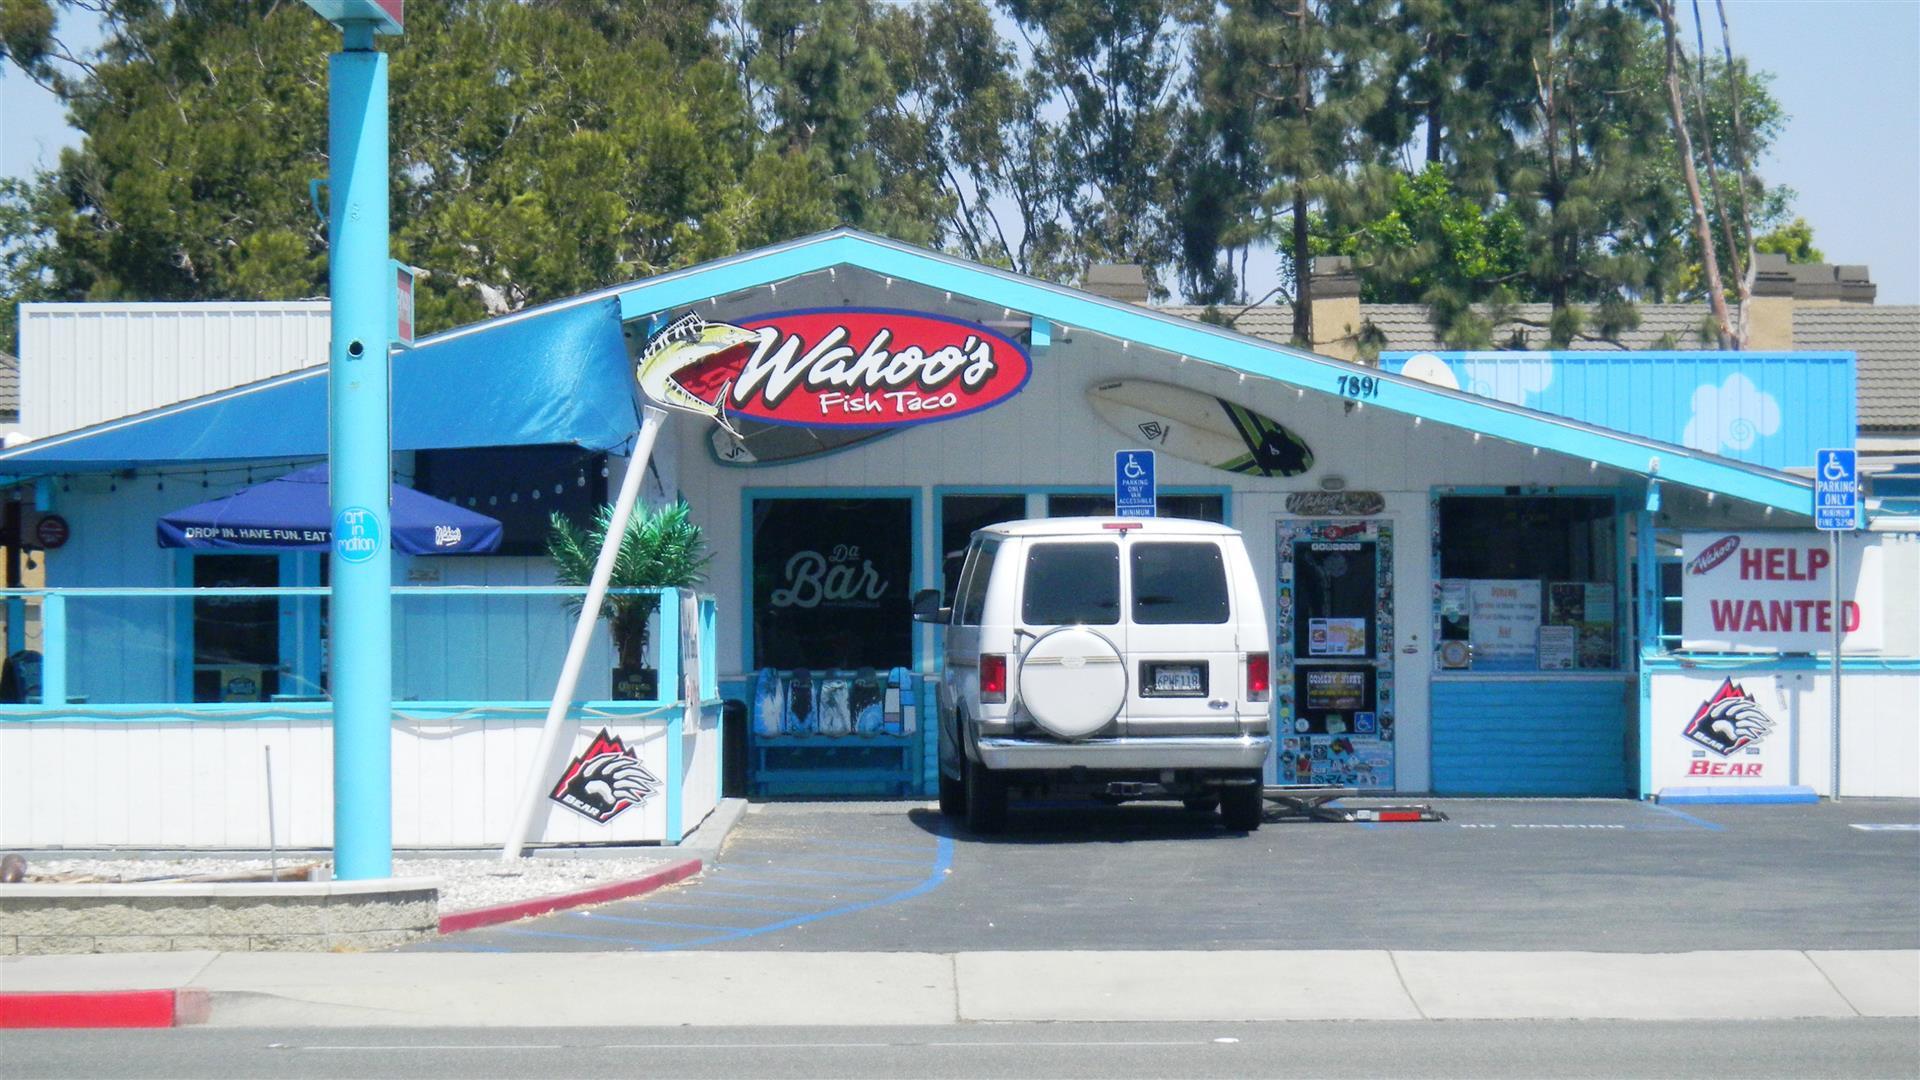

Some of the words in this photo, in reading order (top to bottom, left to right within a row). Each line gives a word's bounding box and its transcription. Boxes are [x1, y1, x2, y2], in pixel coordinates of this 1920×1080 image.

[732, 326, 994, 403] Wahoo's
[1336, 375, 1380, 399] 7891
[819, 391, 883, 414] Fish
[884, 391, 957, 414] Taco
[1818, 480, 1855, 493] PARKING
[1119, 497, 1152, 505] ACCESSIBLE
[1824, 493, 1848, 505] ONLY
[344, 511, 364, 524] art
[1822, 509, 1850, 517] MINIMUM
[351, 520, 365, 536] in
[1818, 518, 1833, 527] FINE
[185, 526, 221, 539] DROP
[221, 527, 239, 540] IN.
[240, 528, 272, 540] HAVE
[274, 529, 302, 541] FUN.
[304, 530, 327, 542] EAT
[337, 537, 376, 551] motion
[828, 544, 860, 562] Da
[1740, 548, 1830, 581] HELP
[770, 550, 889, 609] Bar
[1710, 600, 1861, 632] WANTED
[1157, 674, 1198, 687] 6PWF118
[1693, 731, 1725, 751] BEAR
[562, 794, 601, 816] BEAR
